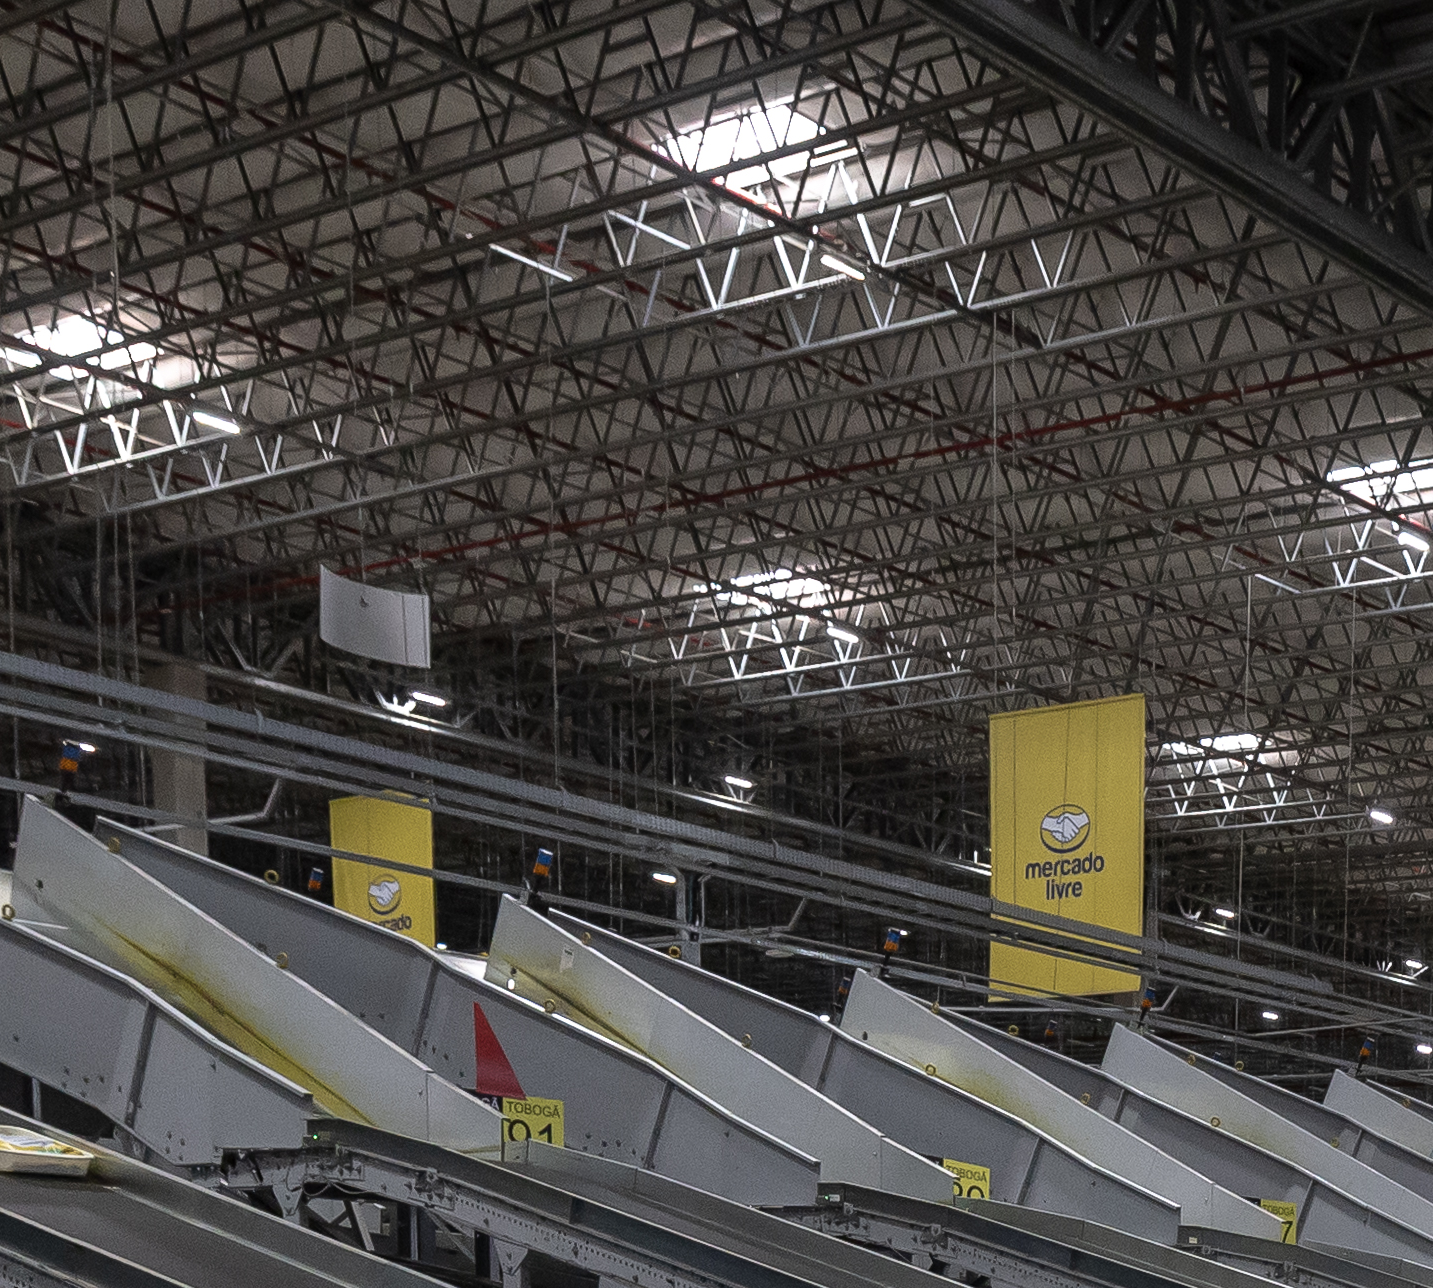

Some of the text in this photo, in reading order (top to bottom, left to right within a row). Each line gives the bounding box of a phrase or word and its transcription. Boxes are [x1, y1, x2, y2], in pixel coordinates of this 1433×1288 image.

[1025, 851, 1105, 879] mercado
[1046, 879, 1083, 900] livre
[506, 1101, 560, 1118] TOBOGÃ
